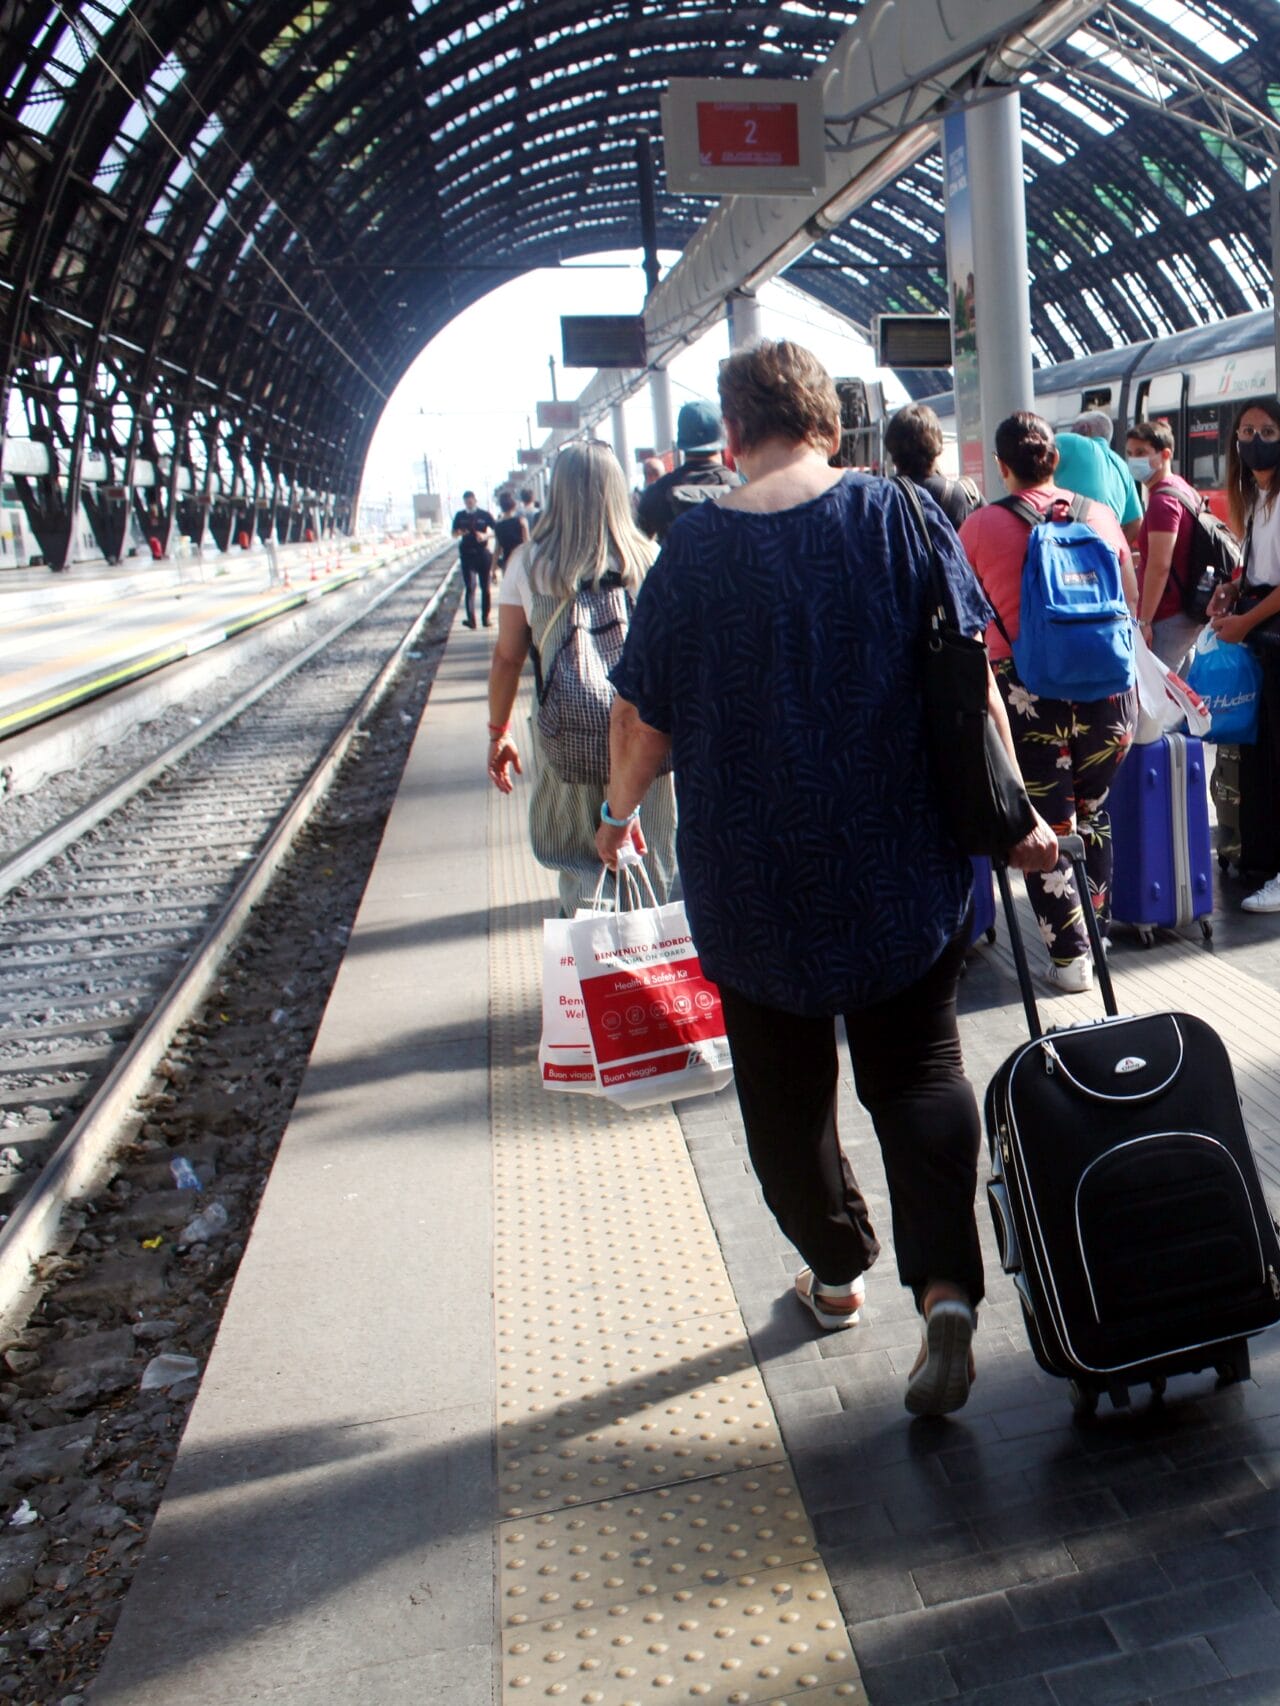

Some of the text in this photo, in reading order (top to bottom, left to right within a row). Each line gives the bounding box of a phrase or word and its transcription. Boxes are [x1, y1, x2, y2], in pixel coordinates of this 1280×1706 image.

[744, 119, 757, 144] 2
[594, 944, 649, 961] BENVENUTO
[659, 935, 692, 949] BORDO
[660, 947, 686, 960] OARD
[560, 956, 577, 967] #R
[614, 977, 642, 991] Health
[651, 972, 676, 984] Safety
[677, 969, 688, 978] Kit
[548, 1068, 568, 1079] Buon
[603, 1065, 657, 1083] Buon viaggio
